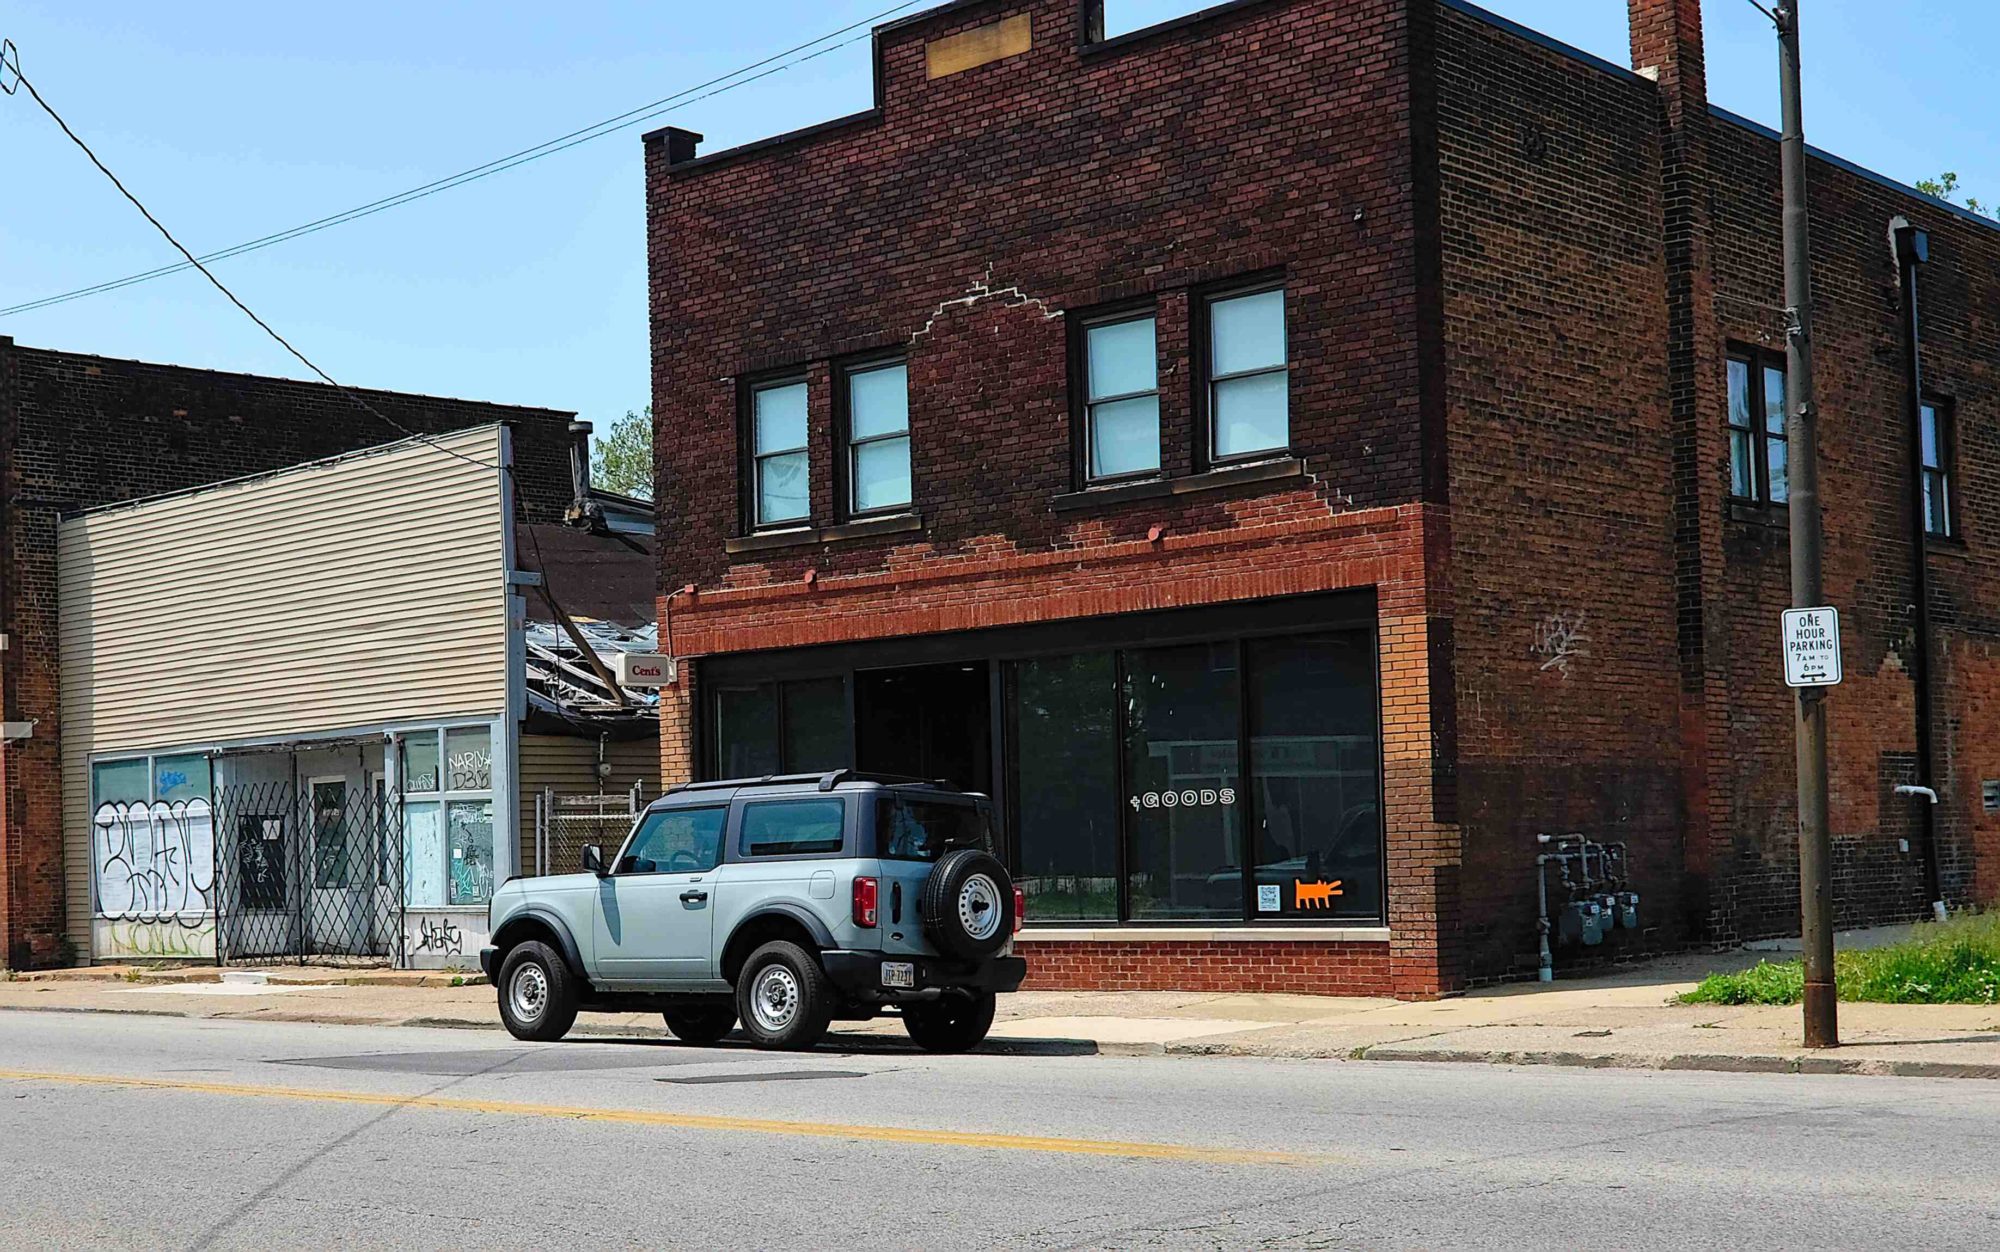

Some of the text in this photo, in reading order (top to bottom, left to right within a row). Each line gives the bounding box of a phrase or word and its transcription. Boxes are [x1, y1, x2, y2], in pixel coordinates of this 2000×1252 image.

[1799, 616, 1821, 627] ONE
[1796, 628, 1825, 639] HOUR
[1790, 640, 1833, 651] PARKING
